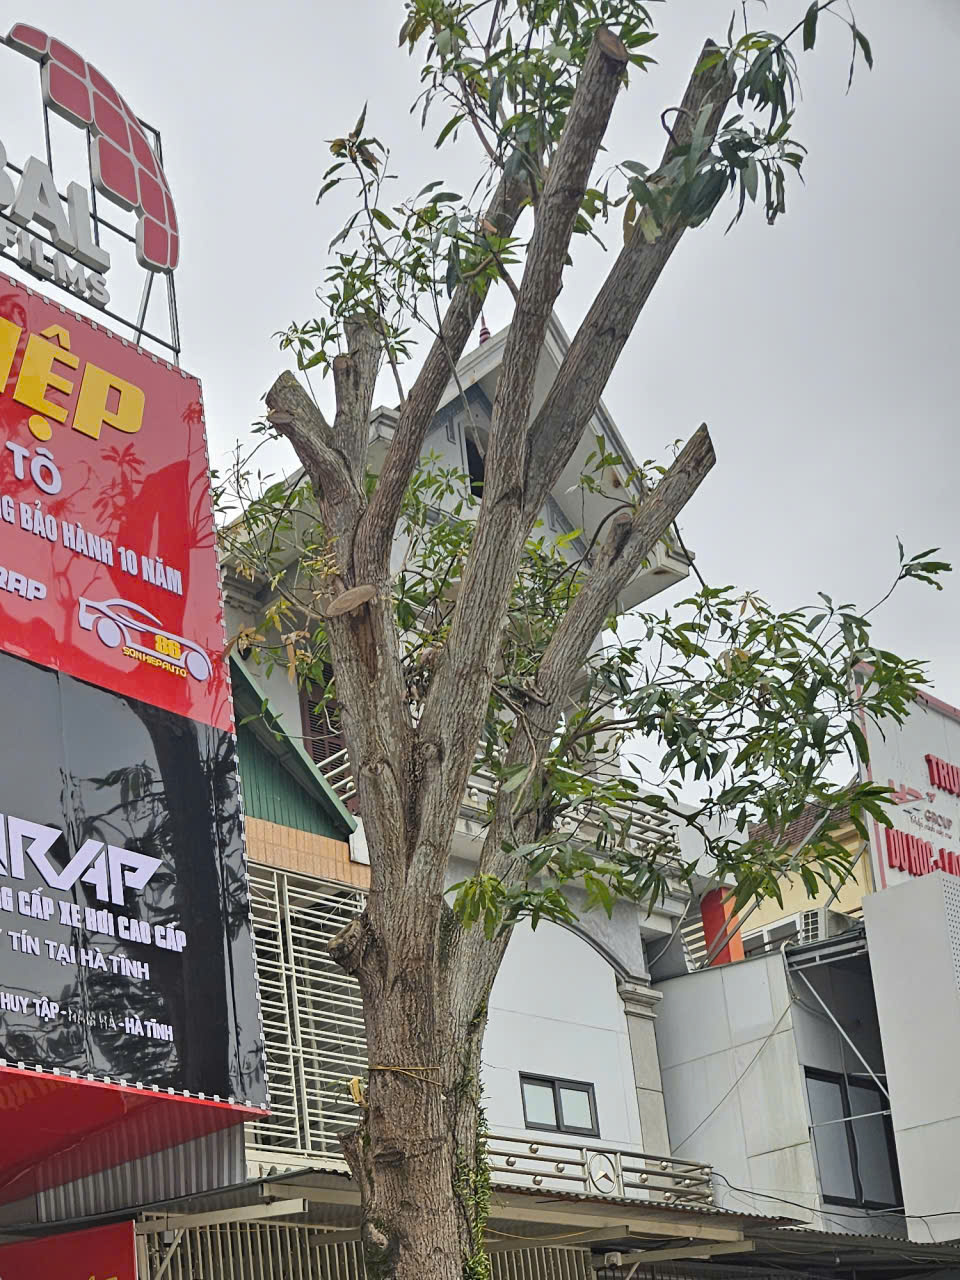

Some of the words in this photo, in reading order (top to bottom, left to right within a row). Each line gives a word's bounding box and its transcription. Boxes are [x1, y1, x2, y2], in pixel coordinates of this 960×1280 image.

[5, 439, 63, 495] TÔ
[19, 499, 59, 544] BẢO
[62, 519, 114, 569] HÀNH
[117, 546, 139, 576] 10
[141, 554, 184, 597] NĂM
[154, 634, 182, 660] 86
[17, 886, 55, 922] CẤP
[58, 900, 82, 929] XE
[84, 906, 115, 937] HƠI
[117, 915, 152, 945] CAO
[153, 921, 187, 953] CẤP
[7, 929, 41, 957] TÍN
[44, 938, 76, 967] TẠI
[80, 947, 108, 973] HÀ
[108, 953, 151, 981] TĨNH
[0, 993, 30, 1015] HUY
[31, 997, 60, 1022] TẬP
[124, 1014, 145, 1037] HÀ
[143, 1018, 174, 1042] TĨNH
